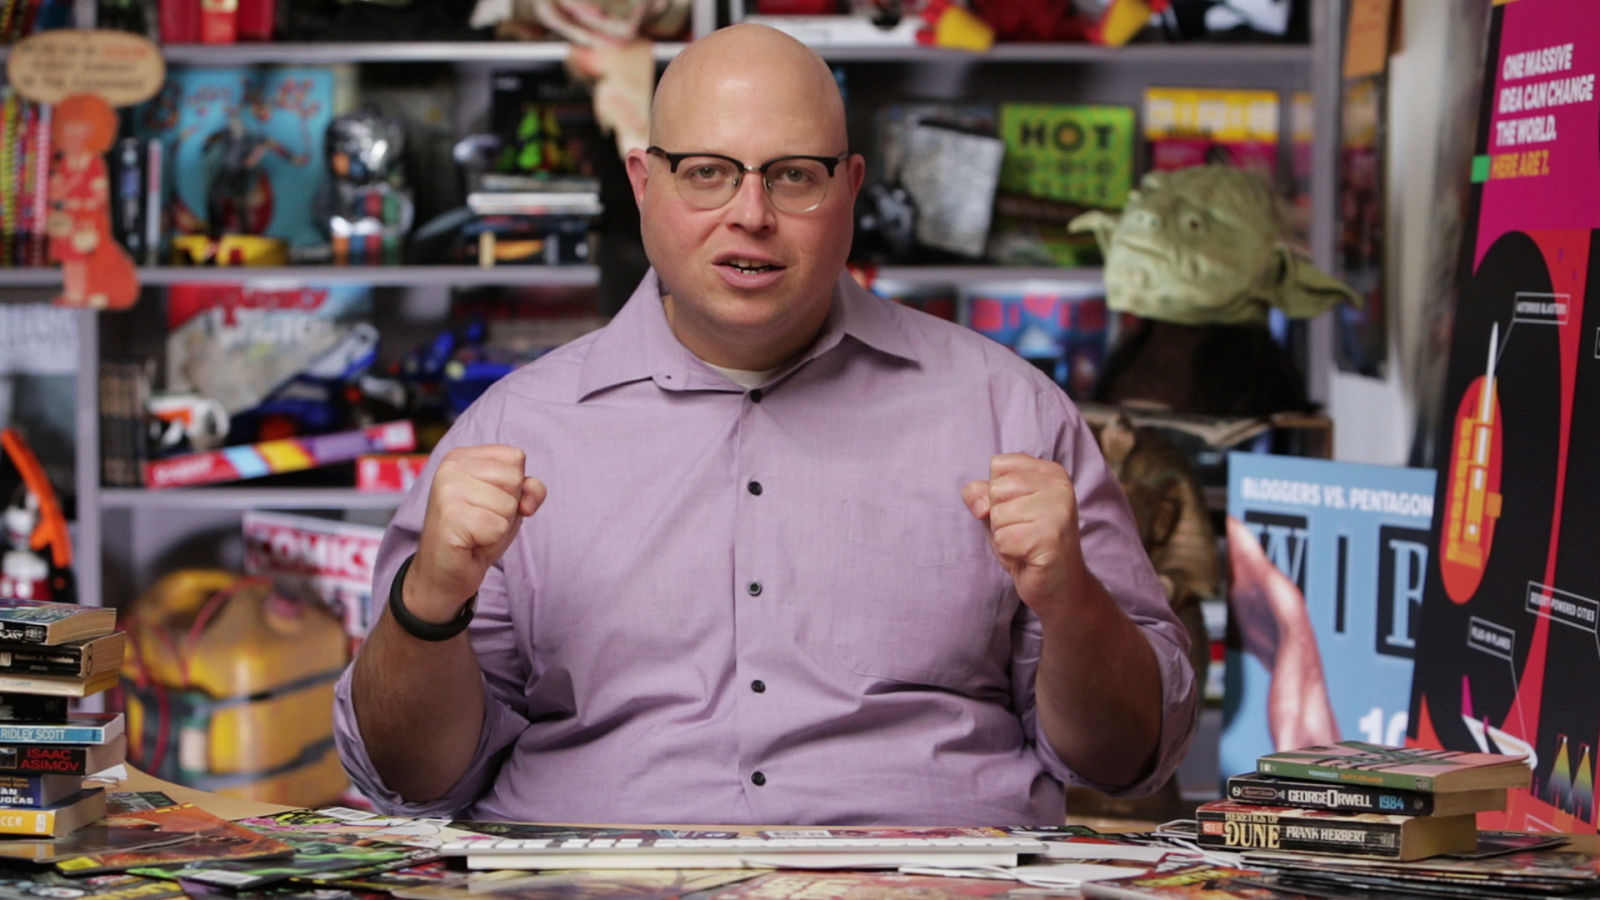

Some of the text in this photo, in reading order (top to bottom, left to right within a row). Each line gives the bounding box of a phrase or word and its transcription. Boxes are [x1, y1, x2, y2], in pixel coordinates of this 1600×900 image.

[1503, 43, 1574, 80] ONE MASSIVE
[1499, 74, 1595, 114] IDEA CAN CHANGE
[1019, 120, 1114, 153] HOT
[1496, 115, 1557, 147] THE WORLD.
[1491, 153, 1519, 179] HERE
[1520, 151, 1541, 177] ARE
[1241, 477, 1434, 517] BLOGGERS VS. PENTAGON
[1576, 606, 1596, 623] CITIES
[1, 728, 66, 741] RIDLEY SCOTT
[21, 759, 80, 771] ASIMOV
[27, 748, 72, 760] ISAAC
[1288, 789, 1328, 803] GEORGE
[1327, 789, 1373, 809] ORWELL
[1379, 795, 1405, 811] 1984
[1225, 811, 1266, 822] HERETICS
[1224, 821, 1281, 849] DUNE
[1286, 826, 1319, 841] FRANK
[1320, 829, 1368, 843] HERBERT
